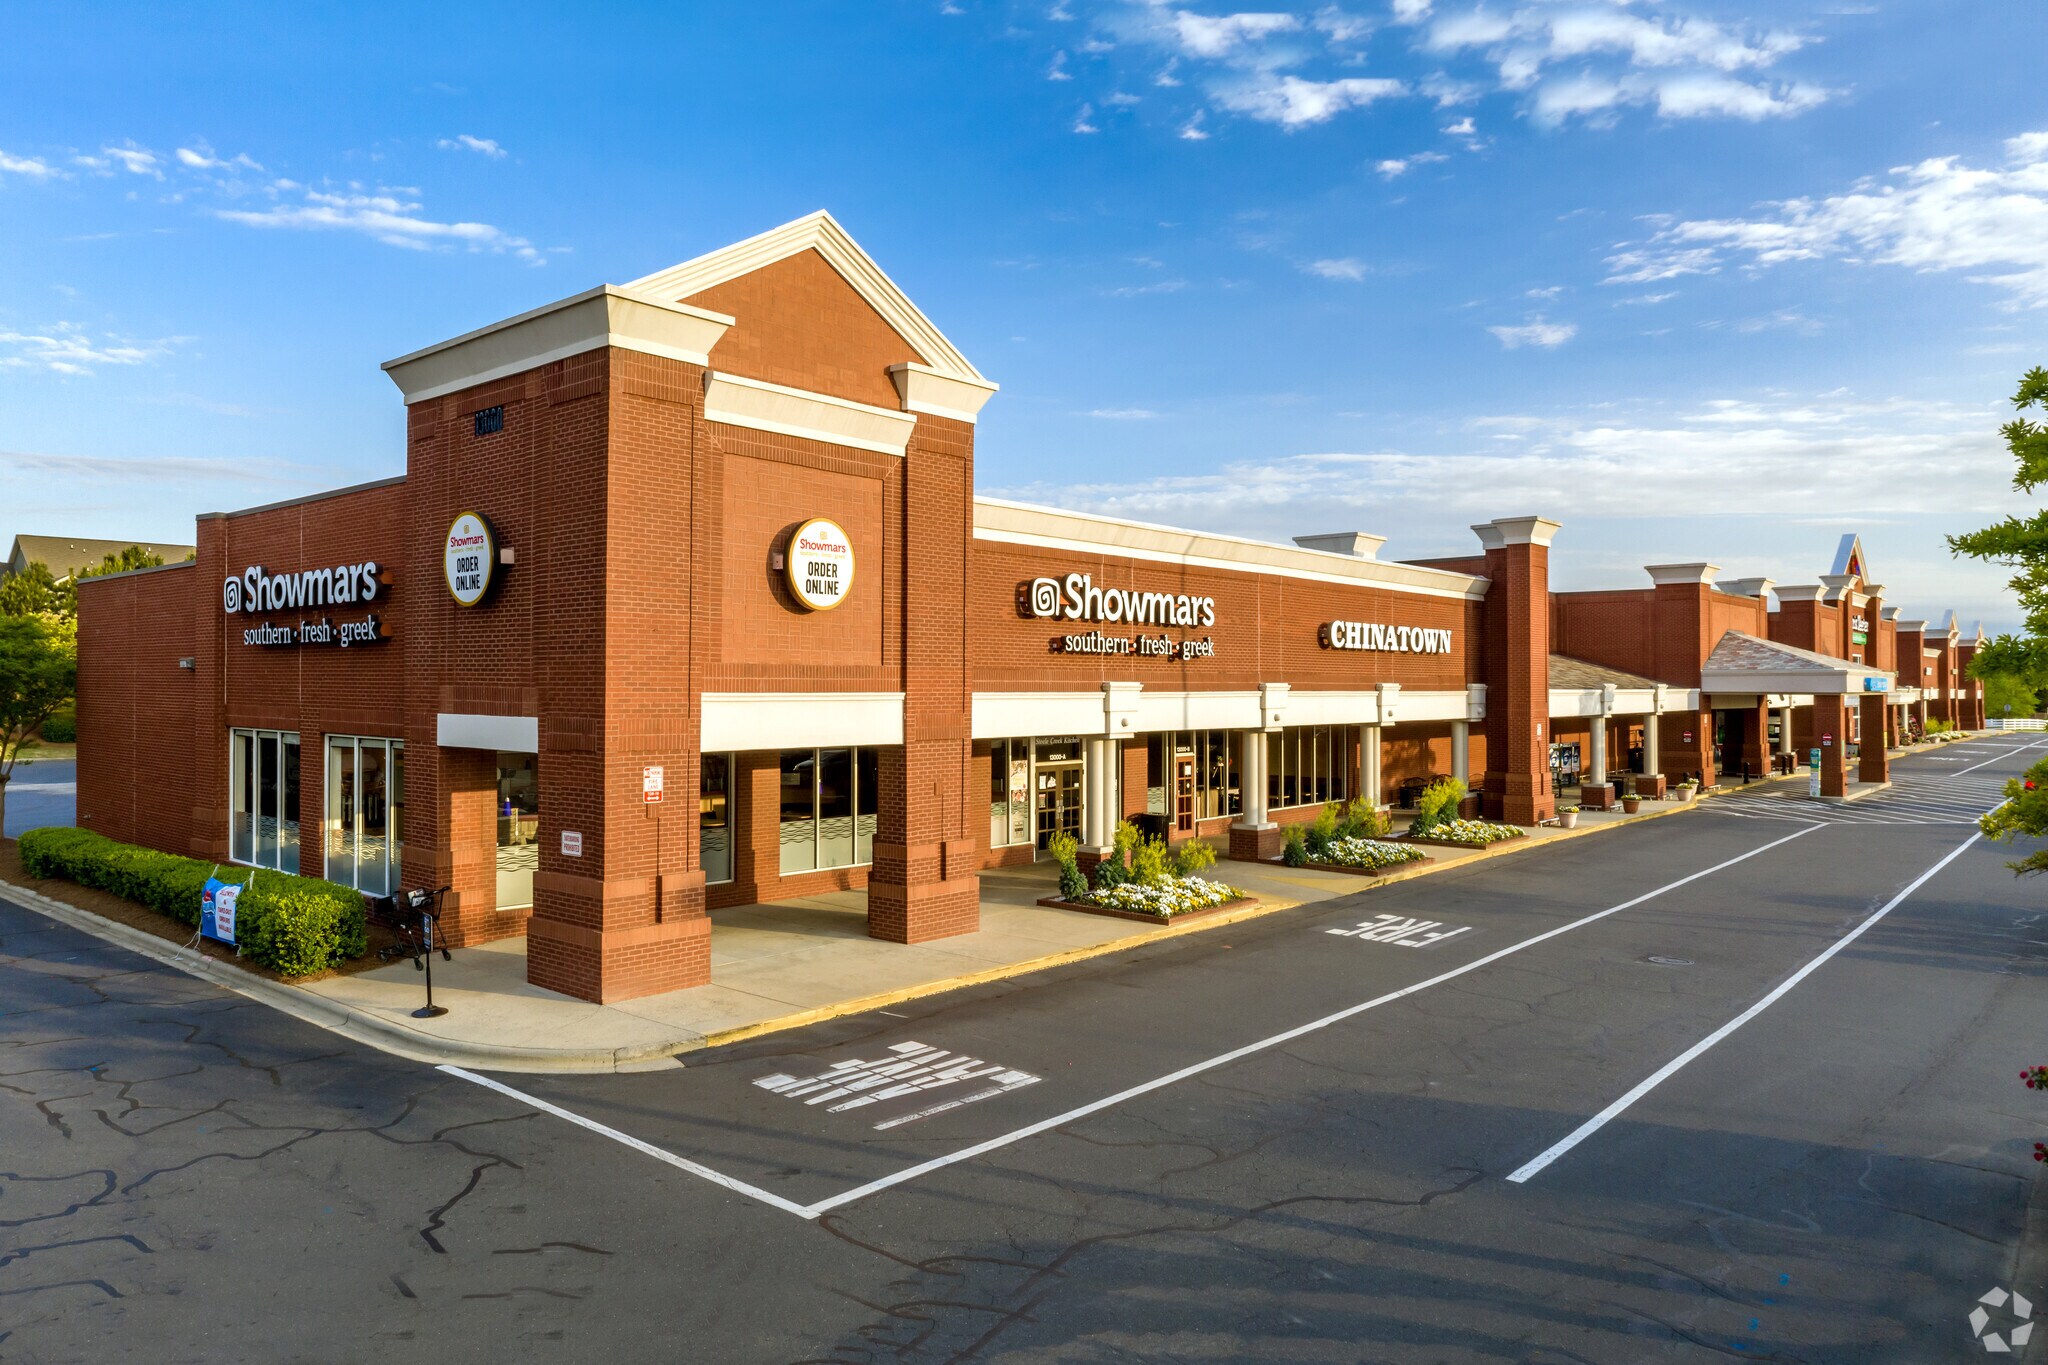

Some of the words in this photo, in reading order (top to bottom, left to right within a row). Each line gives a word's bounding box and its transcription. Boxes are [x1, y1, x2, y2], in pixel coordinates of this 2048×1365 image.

[450, 534, 484, 548] Showmars
[800, 538, 846, 553] Showmars
[456, 556, 479, 573] ORDER
[808, 561, 838, 578] ORDER
[244, 561, 376, 612] Showmars
[455, 574, 481, 591] ONLINE
[805, 579, 839, 595] ONLINE
[1064, 573, 1215, 627] Showmars
[244, 621, 291, 645] southern
[300, 617, 331, 643] fresh
[340, 614, 377, 647] greek
[1331, 620, 1452, 654] CHINATOWN
[1065, 630, 1130, 654] southern
[1140, 634, 1173, 656] fresh
[1183, 637, 1215, 661] greek
[1325, 913, 1473, 948] FIRE
